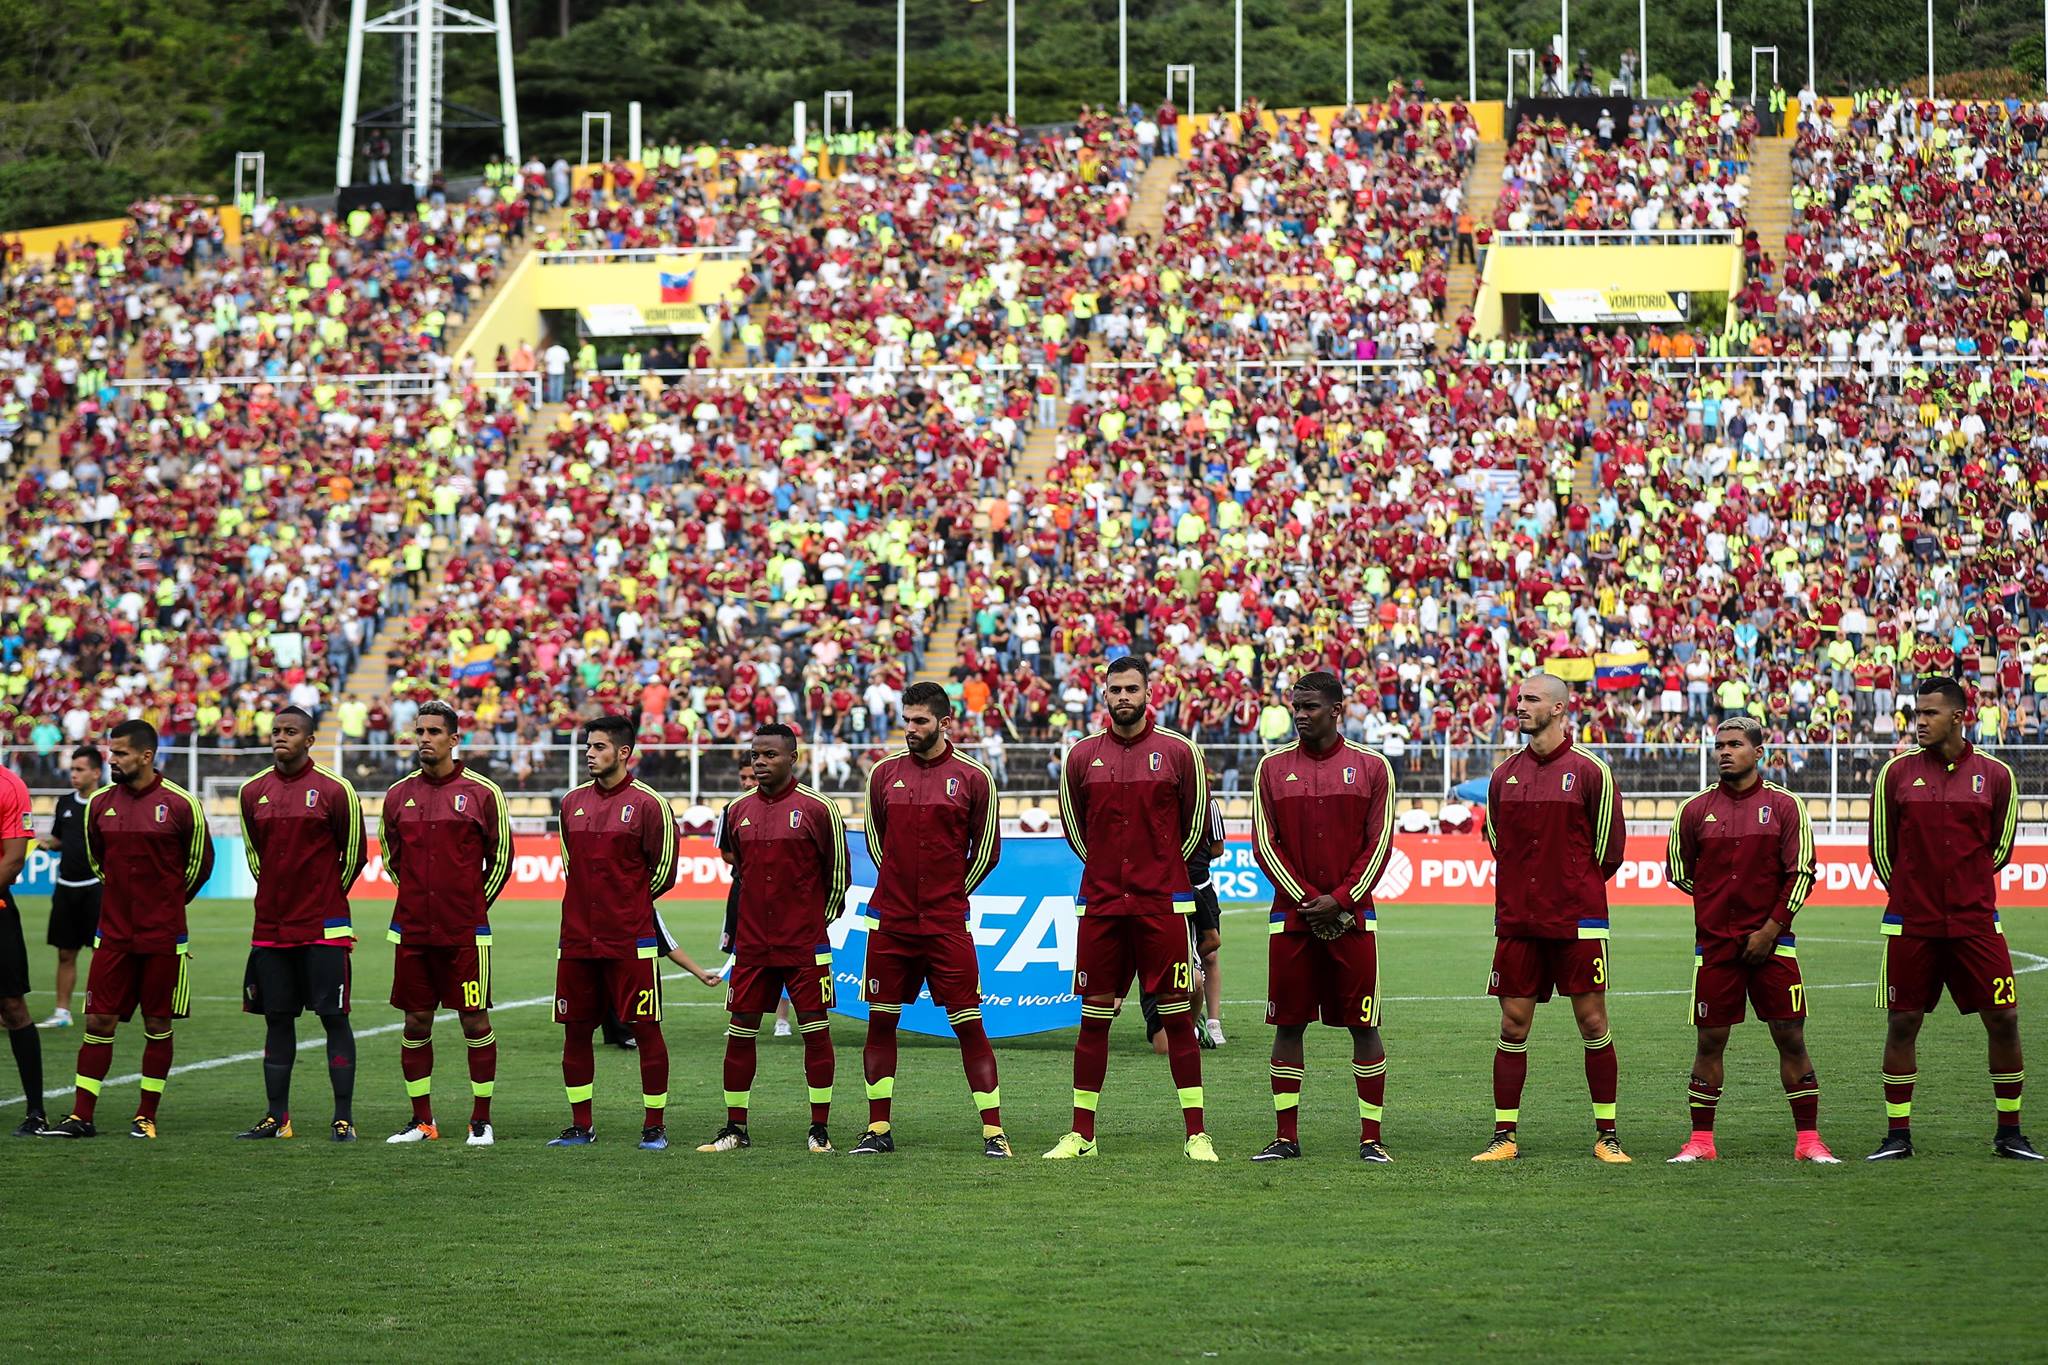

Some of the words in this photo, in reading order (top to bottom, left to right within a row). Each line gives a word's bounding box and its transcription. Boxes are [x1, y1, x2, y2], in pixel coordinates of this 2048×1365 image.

[1609, 294, 1666, 308] VOMITORIO
[2000, 863, 2048, 891] PD
[1173, 962, 1188, 988] 13
[1593, 957, 1604, 984] 3
[338, 983, 344, 1008] 1
[461, 980, 480, 1007] 18
[636, 989, 653, 1015] 21
[819, 975, 831, 1003] 15
[1017, 992, 1078, 1006] World.
[1788, 984, 1802, 1012] 17
[1993, 976, 2015, 1004] 23
[1360, 995, 1372, 1022] 9
